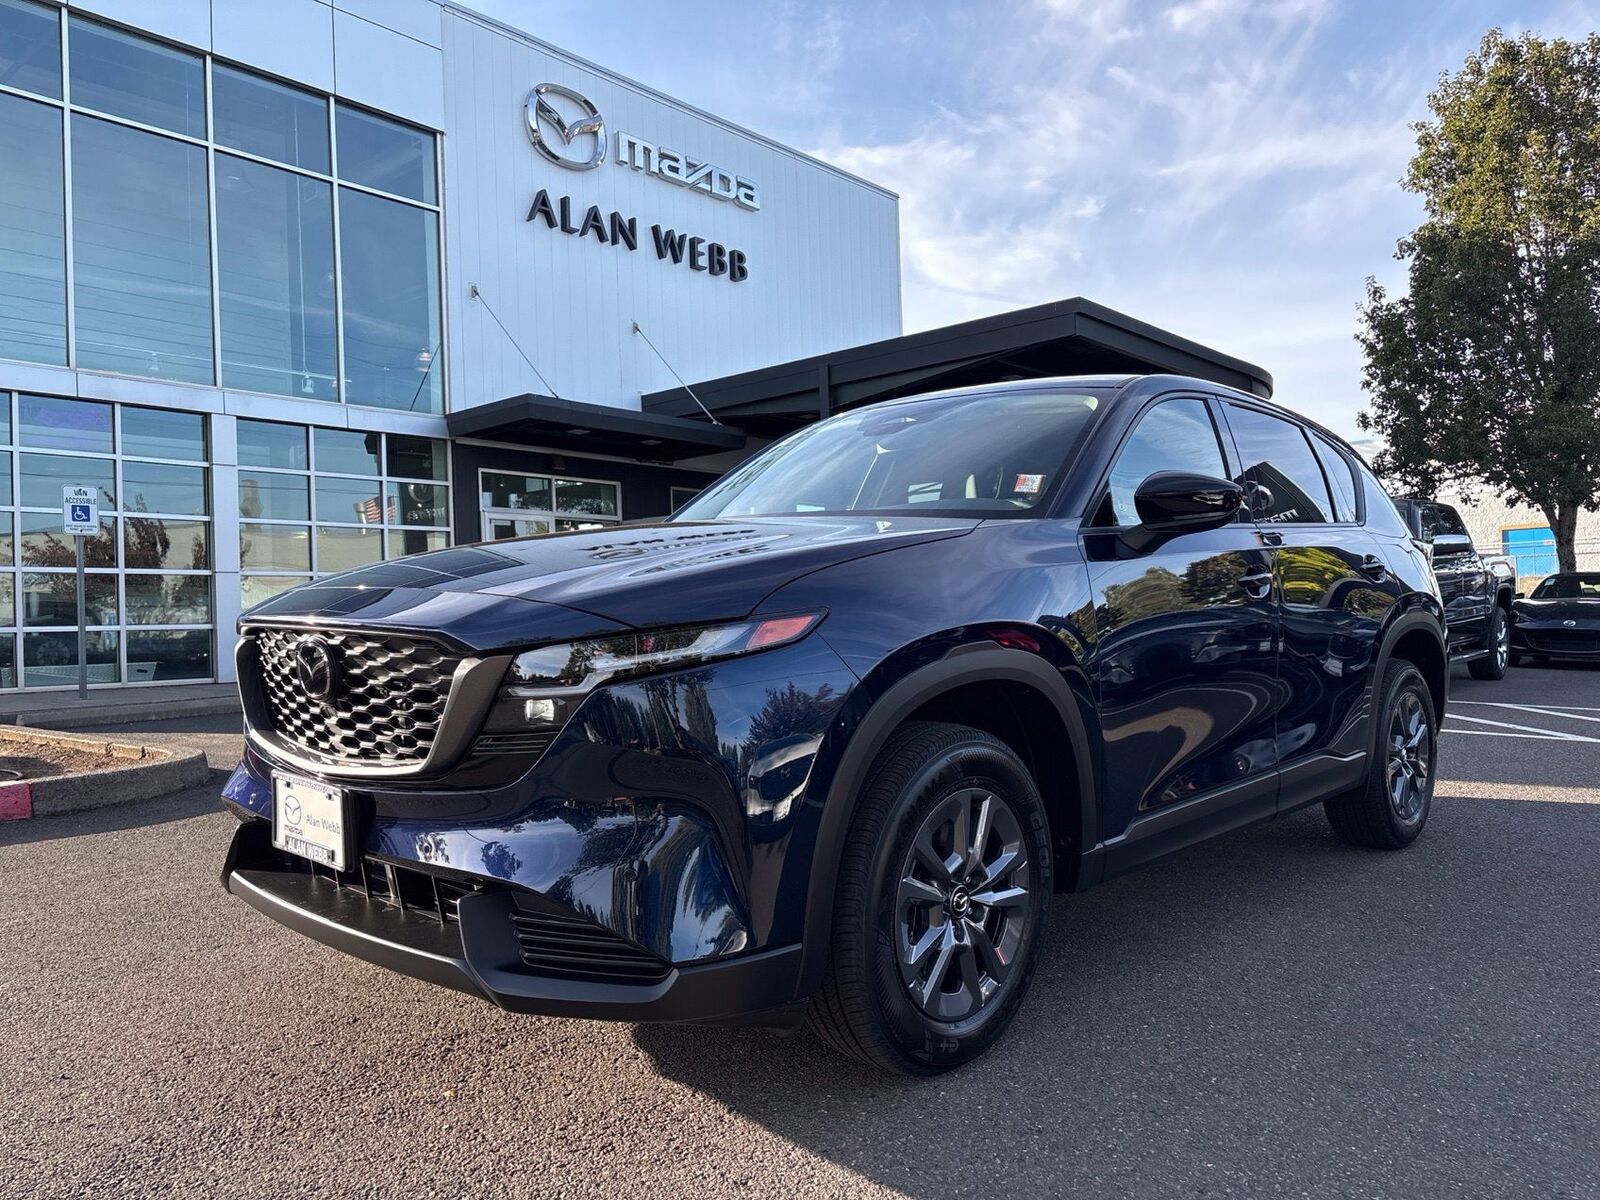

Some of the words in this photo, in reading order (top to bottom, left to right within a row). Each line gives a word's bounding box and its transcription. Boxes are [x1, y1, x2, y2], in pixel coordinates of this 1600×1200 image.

[526, 188, 638, 251] ALAN
[651, 224, 748, 282] WEBB
[65, 497, 97, 505] ACCESSIBLE
[73, 488, 88, 496] VAN
[306, 814, 320, 828] Alan
[321, 818, 340, 834] Webb
[288, 837, 306, 857] ALAN
[307, 843, 328, 864] WEBB
